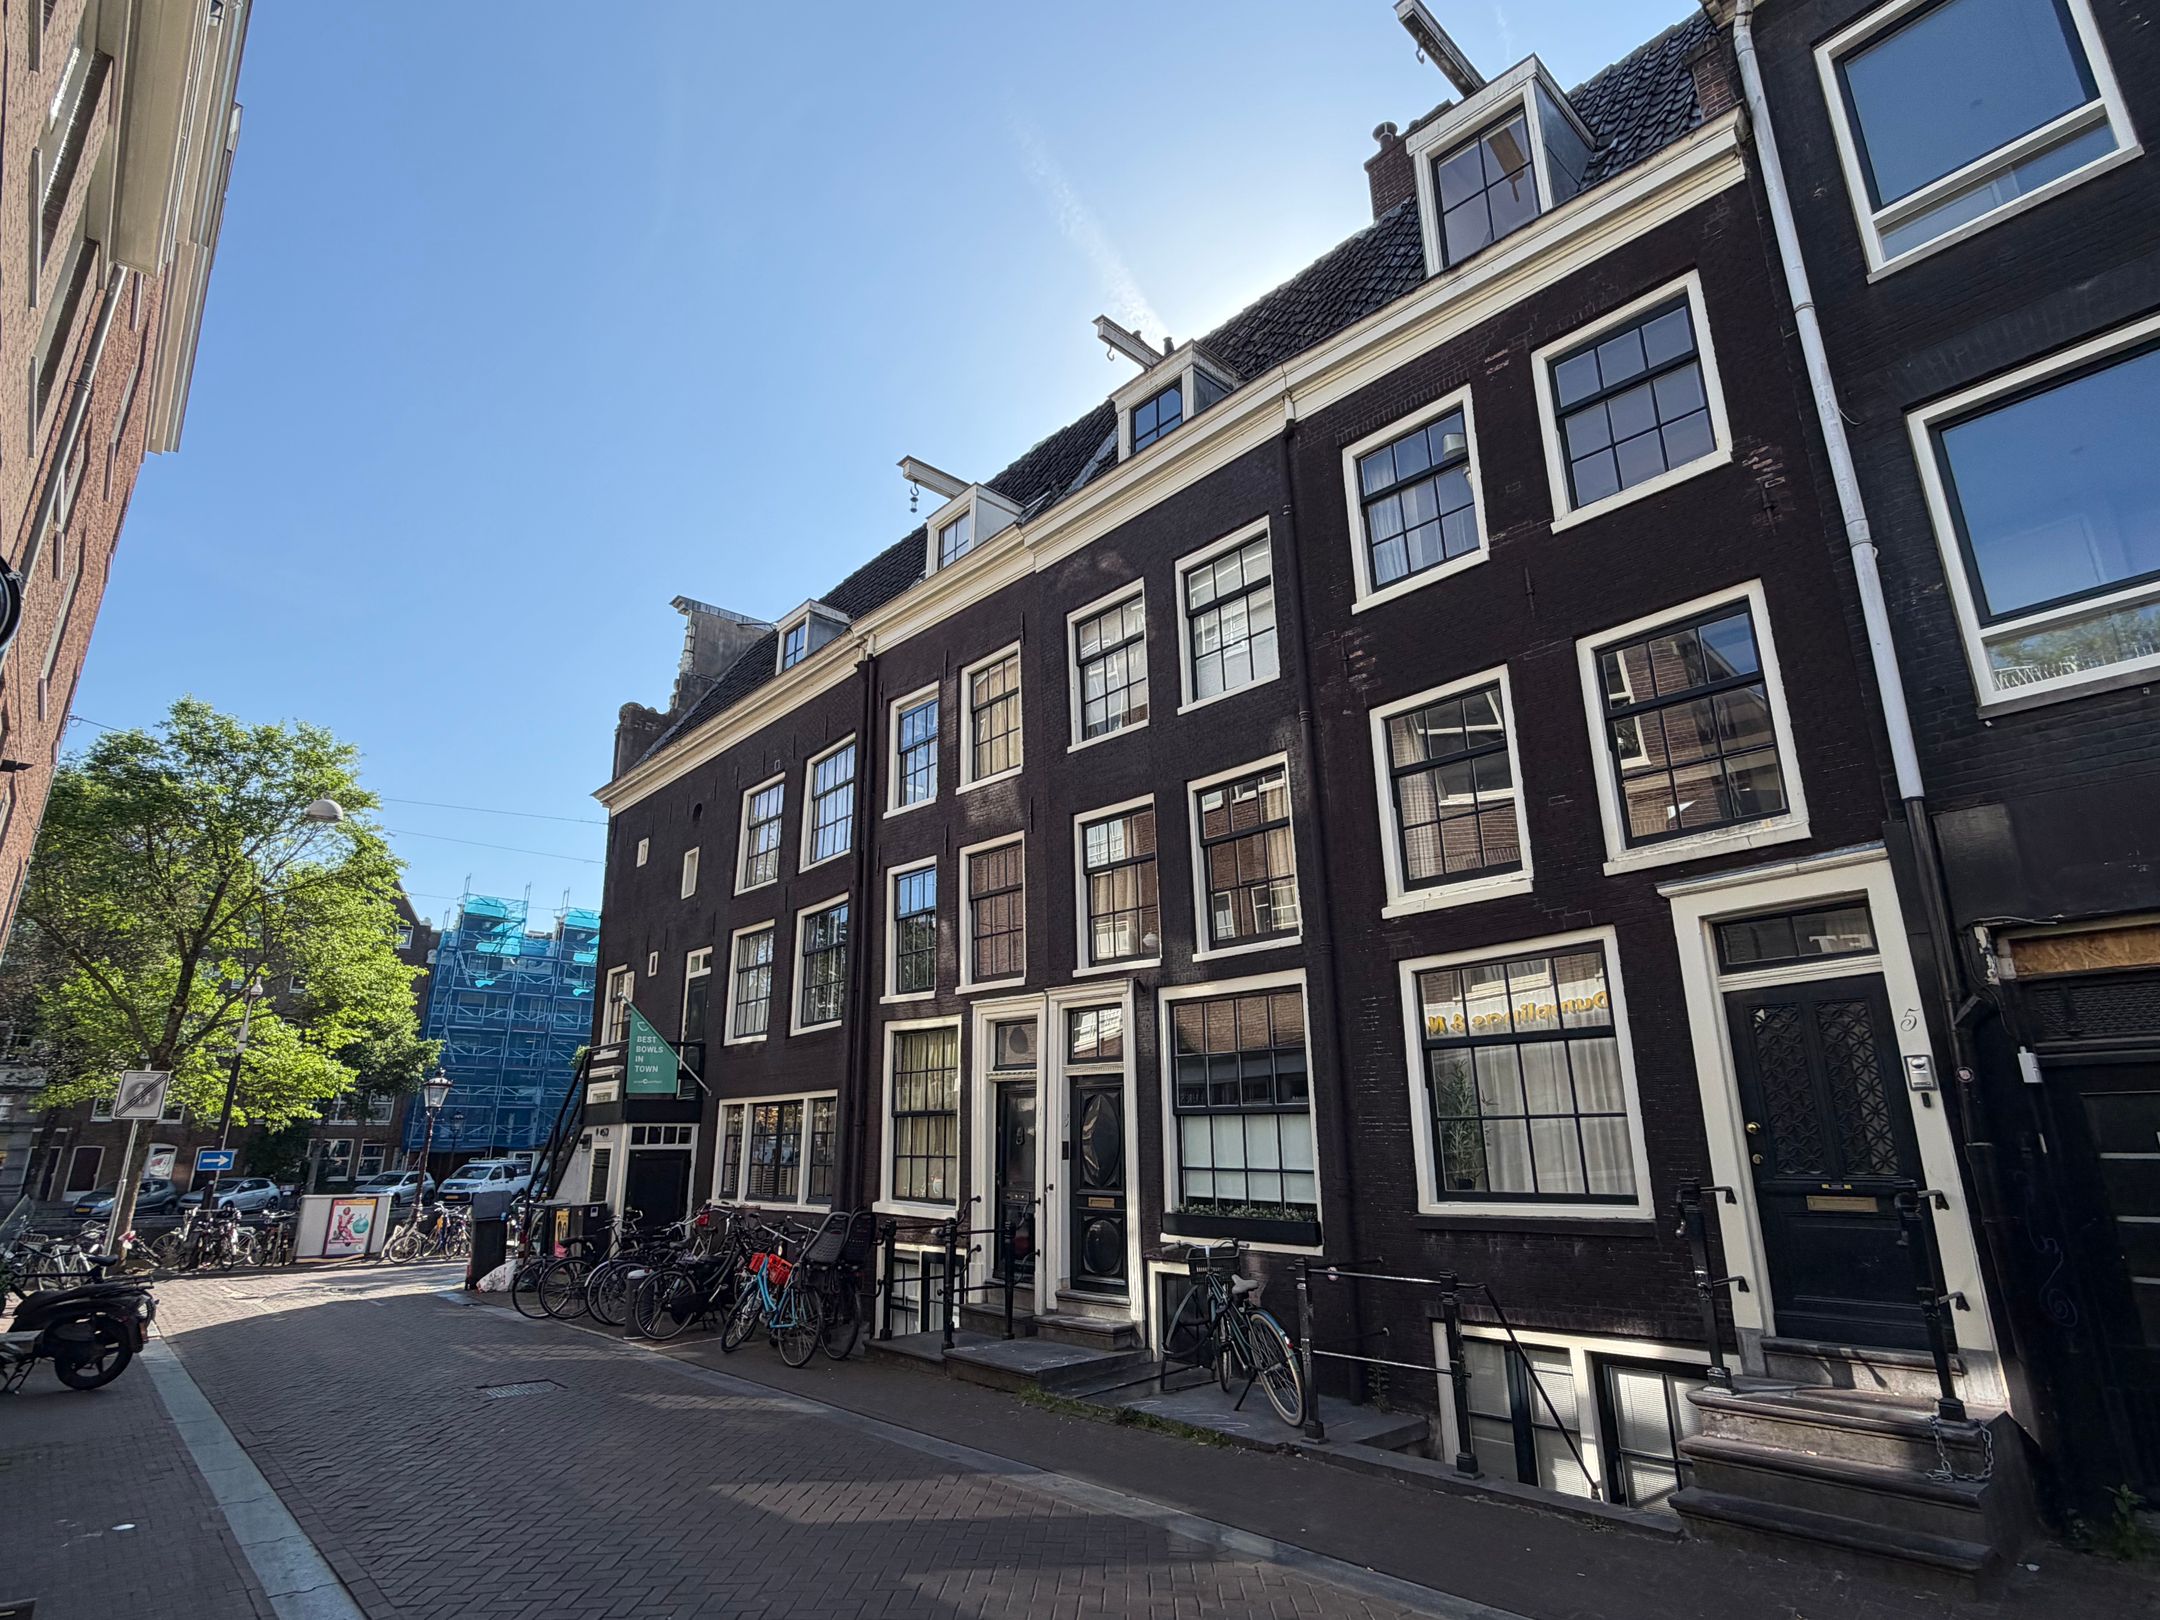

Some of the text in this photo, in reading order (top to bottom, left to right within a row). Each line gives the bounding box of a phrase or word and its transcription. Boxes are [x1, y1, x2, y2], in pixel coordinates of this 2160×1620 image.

[1900, 1008, 1920, 1032] 5
[636, 1036, 657, 1044] BEST
[635, 1046, 664, 1054] BOWLS
[635, 1055, 644, 1063] IN
[634, 1065, 659, 1073] TOWN
